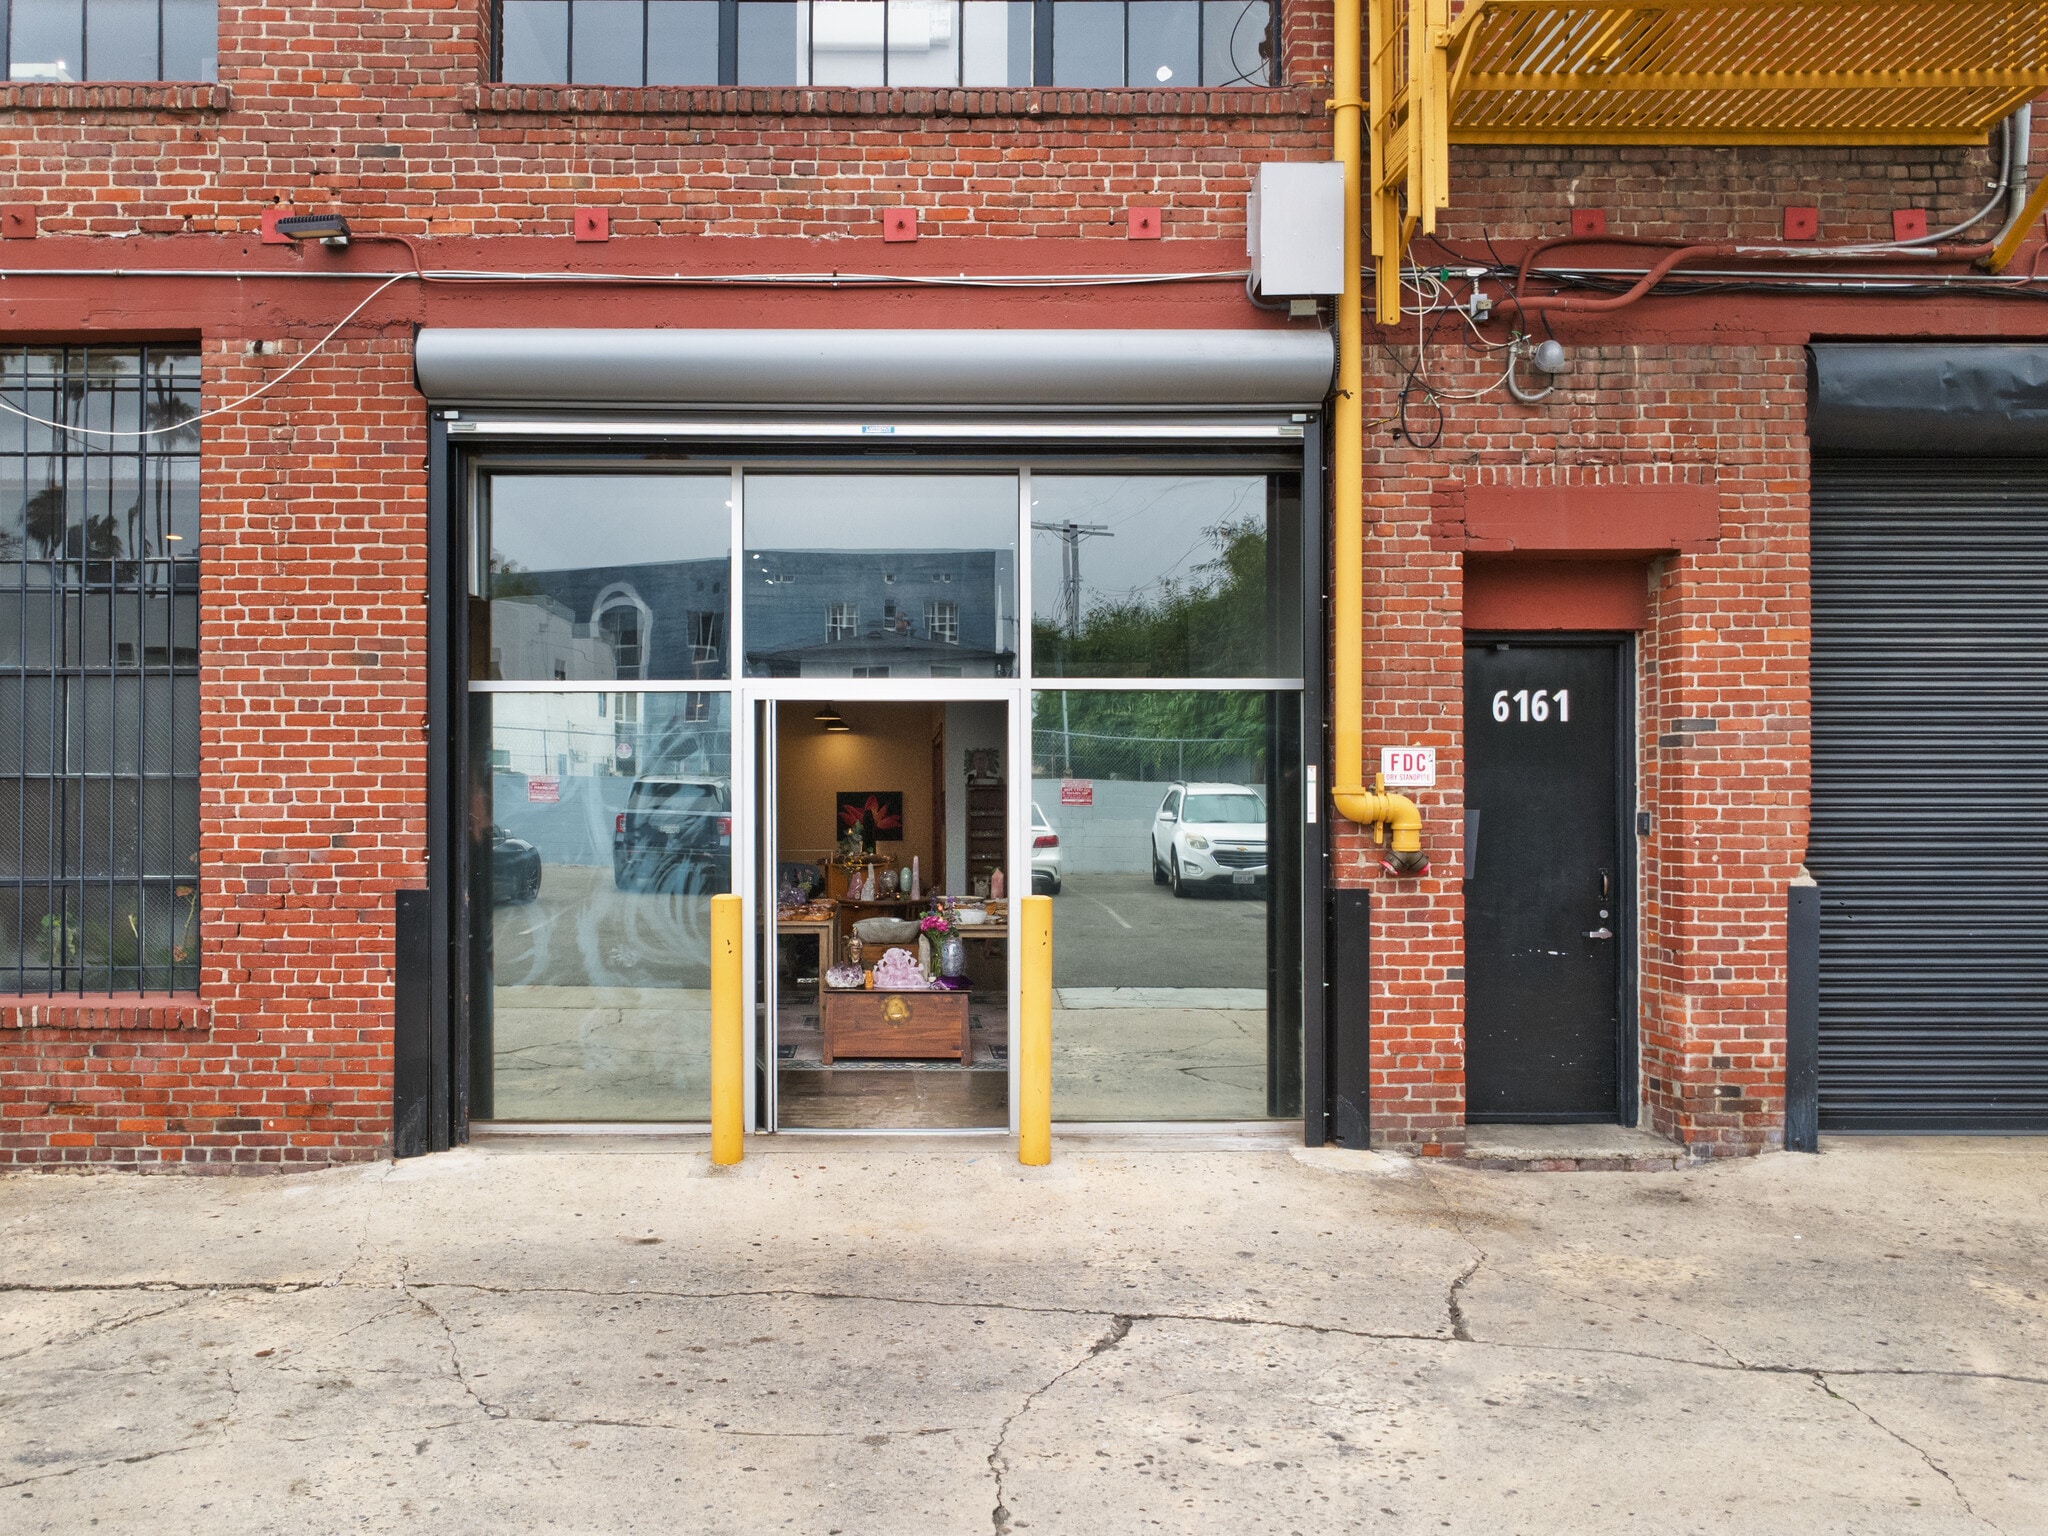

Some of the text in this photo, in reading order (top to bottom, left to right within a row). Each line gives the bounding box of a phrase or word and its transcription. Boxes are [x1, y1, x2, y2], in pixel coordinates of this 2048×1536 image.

[1492, 689, 1569, 722] 6161
[1391, 753, 1426, 772] FDC
[1386, 773, 1398, 781] DRY
